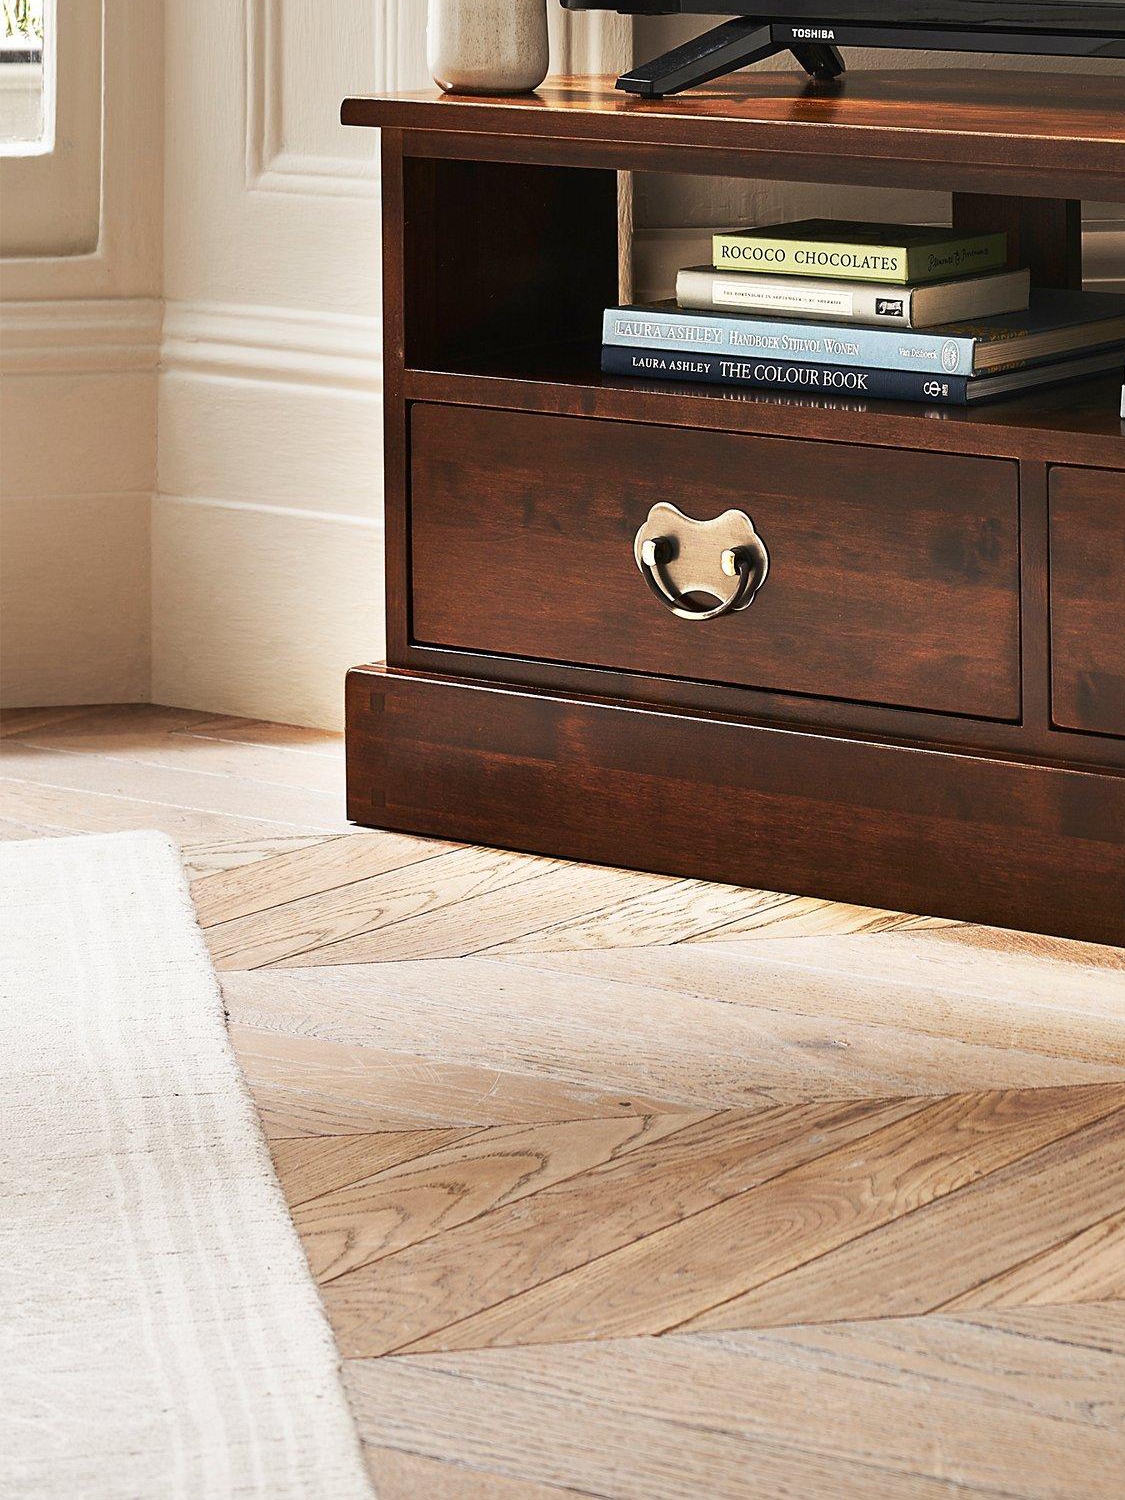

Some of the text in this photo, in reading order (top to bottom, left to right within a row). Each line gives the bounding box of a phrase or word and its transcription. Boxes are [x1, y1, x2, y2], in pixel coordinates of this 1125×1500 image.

[791, 28, 835, 39] TOSHIBA
[721, 245, 898, 271] ROCOCO CHOCOLATES
[616, 321, 662, 338] LAURA
[667, 327, 721, 342] ASHLEY
[729, 330, 780, 349] HANDBOEK
[824, 338, 860, 355] WONEN
[632, 356, 869, 390] LAURA ASHLEY THE COLOUR BOOK
